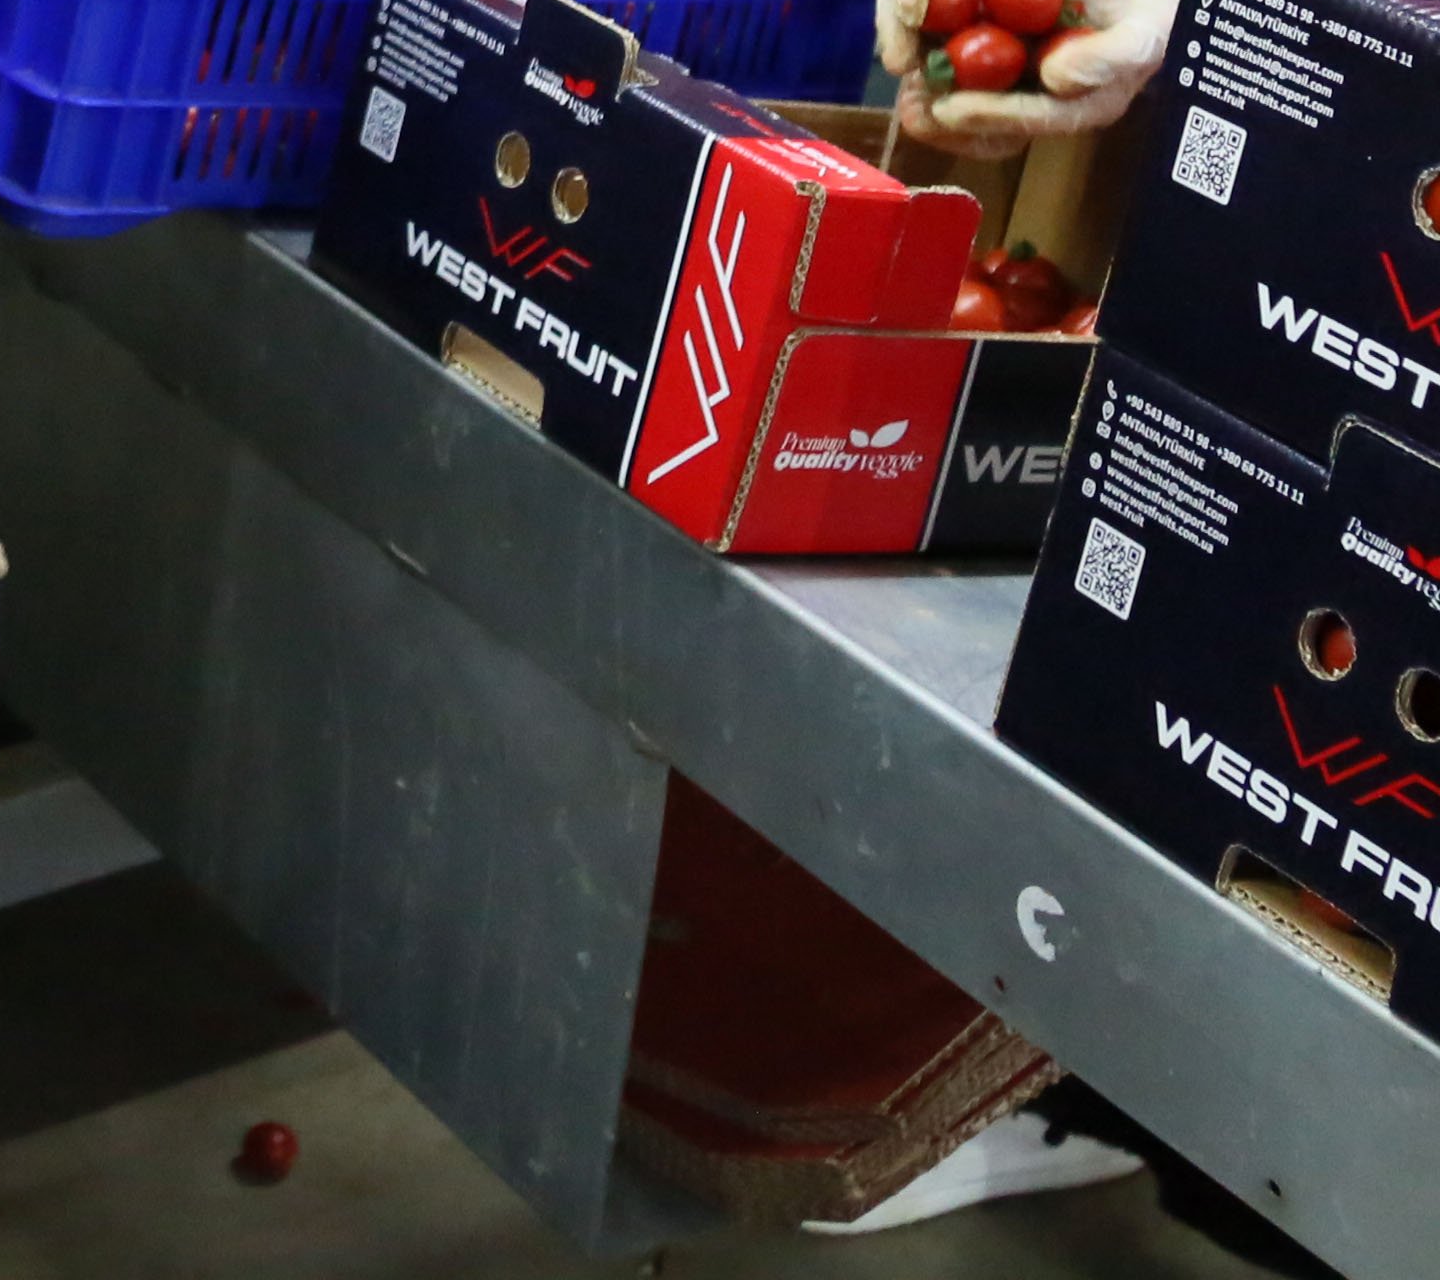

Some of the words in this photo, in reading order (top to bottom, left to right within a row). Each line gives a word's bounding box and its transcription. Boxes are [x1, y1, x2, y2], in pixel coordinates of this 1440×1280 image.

[1209, 34, 1333, 99] westfruitsltd@gmail.com
[1214, 16, 1345, 86] info@westfruitexport.com
[1285, 1, 1300, 18] 31
[1299, 7, 1314, 25] 98
[1320, 17, 1348, 39] +380
[1347, 28, 1363, 45] 68
[1362, 34, 1384, 54] 775
[1383, 44, 1399, 62] 11
[1399, 51, 1414, 69] 11
[1198, 80, 1246, 111] west.fruit
[1202, 66, 1319, 129] www.westfruits.com.ua
[1205, 51, 1335, 119] www.westfruitexport.com
[480, 197, 592, 285] WF
[405, 220, 517, 318] WEST
[514, 296, 638, 400] FRUIT
[647, 162, 747, 486] WF
[773, 449, 861, 472] Quality
[860, 450, 923, 480] veggie
[781, 431, 848, 453] Premium
[962, 444, 1066, 484] WE
[1114, 430, 1239, 514] info@westfruitexport.com
[1119, 412, 1206, 471] ANTALYA/TÜRKİYE
[1125, 394, 1144, 412] +90
[1144, 402, 1163, 422] 543
[1162, 413, 1183, 433] 889
[1182, 424, 1195, 440] 31
[1195, 432, 1210, 450] 98
[1216, 443, 1242, 469] +380
[1241, 459, 1256, 477] 68
[1256, 467, 1276, 488] 775
[1275, 480, 1290, 498] 11
[1290, 487, 1305, 506] 11
[1099, 493, 1145, 528] west.fruit
[1103, 480, 1215, 554] www.westfruits.com.ua
[1106, 464, 1230, 546] www.westfruitexport.com
[1110, 448, 1228, 526] westfruitsltd@gmail.com
[1340, 532, 1418, 585] Quality
[1346, 516, 1405, 561] Premium
[1155, 700, 1339, 847] WEST
